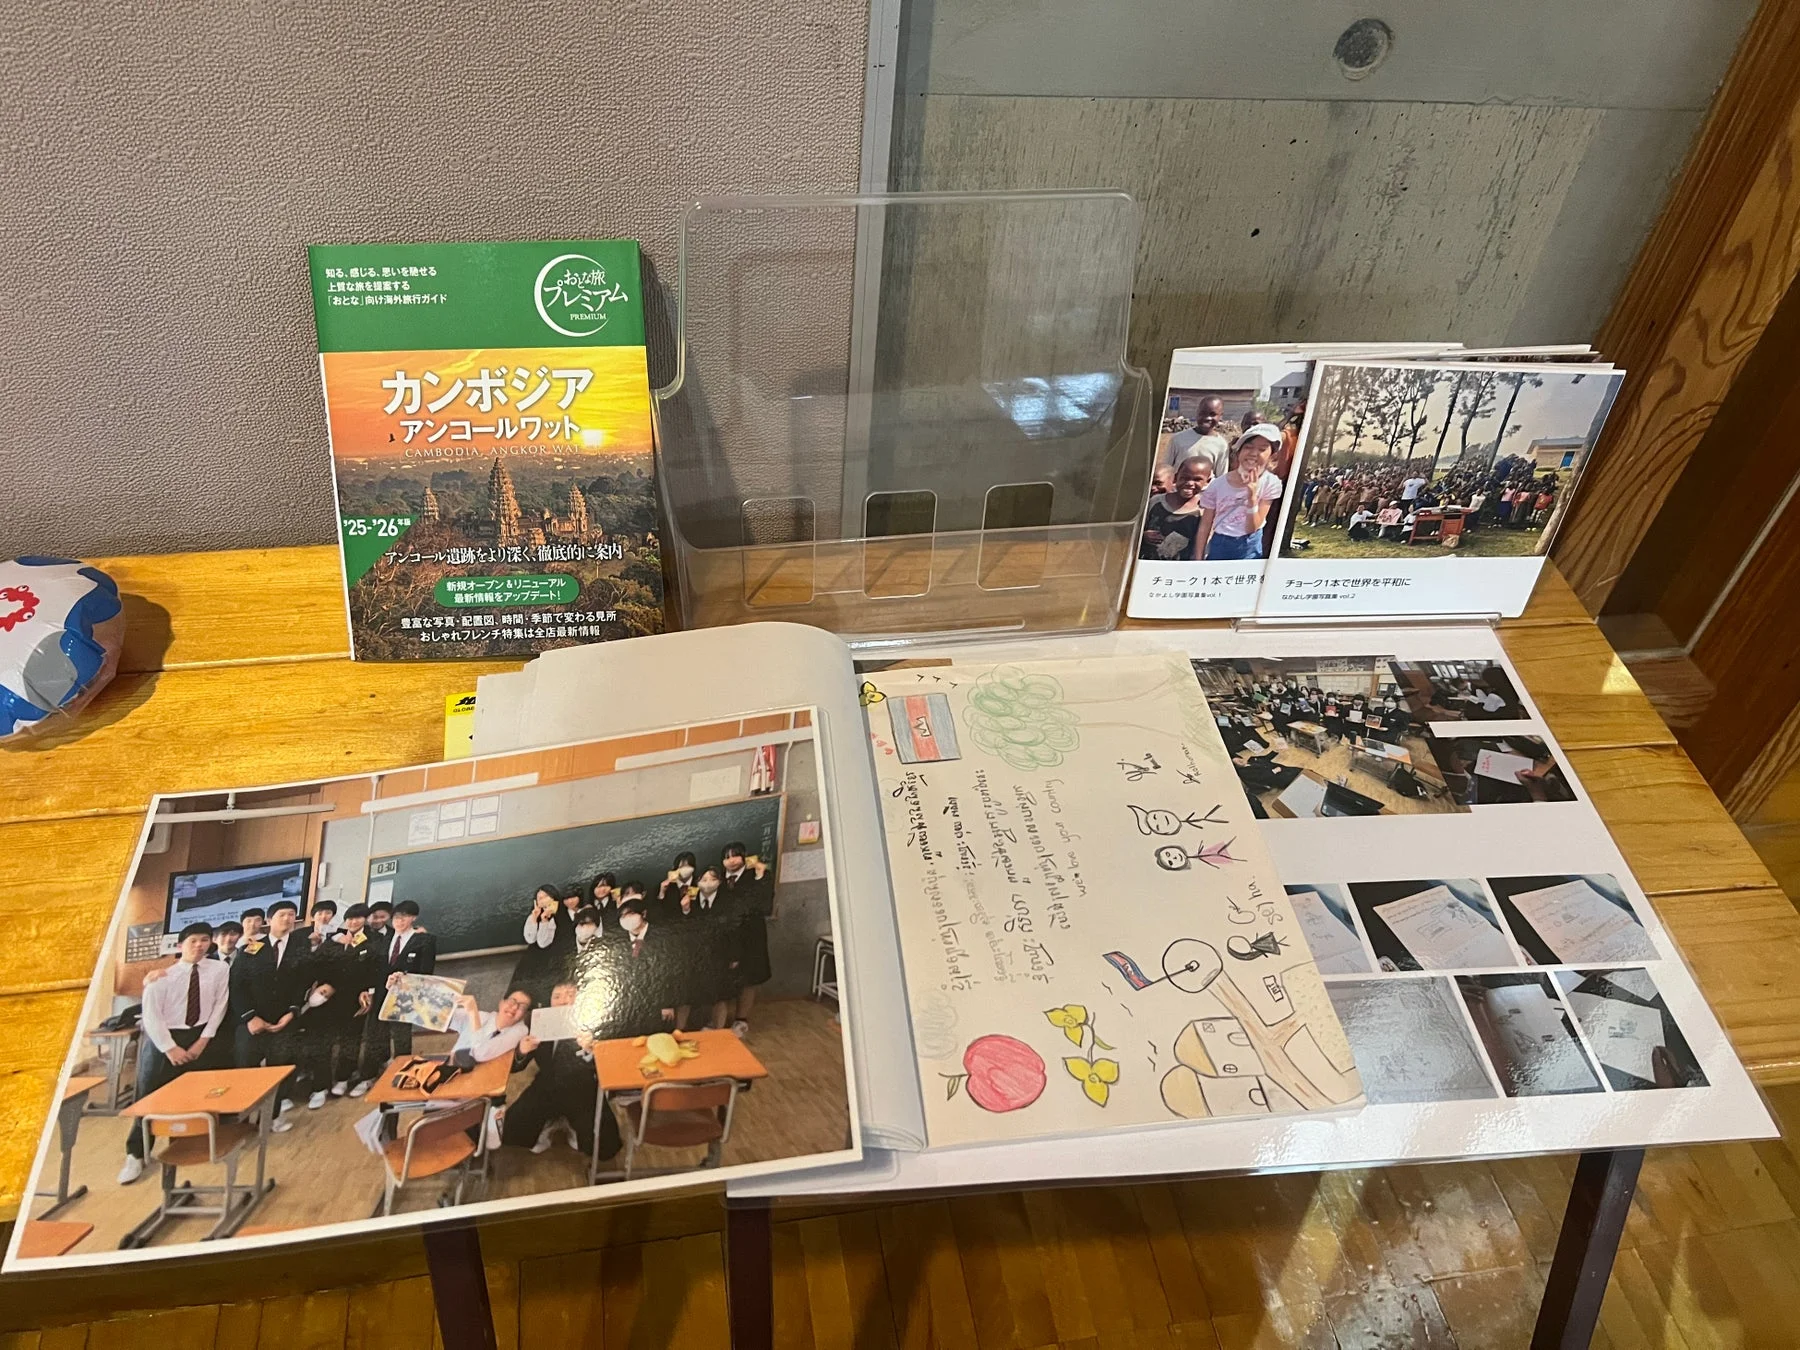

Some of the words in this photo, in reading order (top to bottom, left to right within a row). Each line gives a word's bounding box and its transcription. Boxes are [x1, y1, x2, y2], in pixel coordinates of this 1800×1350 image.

[328, 281, 411, 292] 上質な旅を提案する
[563, 269, 607, 289] おとな旅
[328, 294, 447, 306] 「おとな」向け海外旅行ガイド
[543, 279, 629, 312] プレミアム
[382, 365, 595, 415] カンボジア
[400, 416, 581, 444] アンコールワット
[405, 447, 484, 458] CAMBODIA,
[490, 445, 547, 455] ANGKOR
[552, 443, 580, 453] WAT
[385, 543, 623, 565] アンコール遺跡をより深く、徹底的に案内
[1285, 577, 1411, 588] チョーク1本で世界を平和に
[420, 626, 600, 642] おしゃれフレンチ特集は全店最新情報
